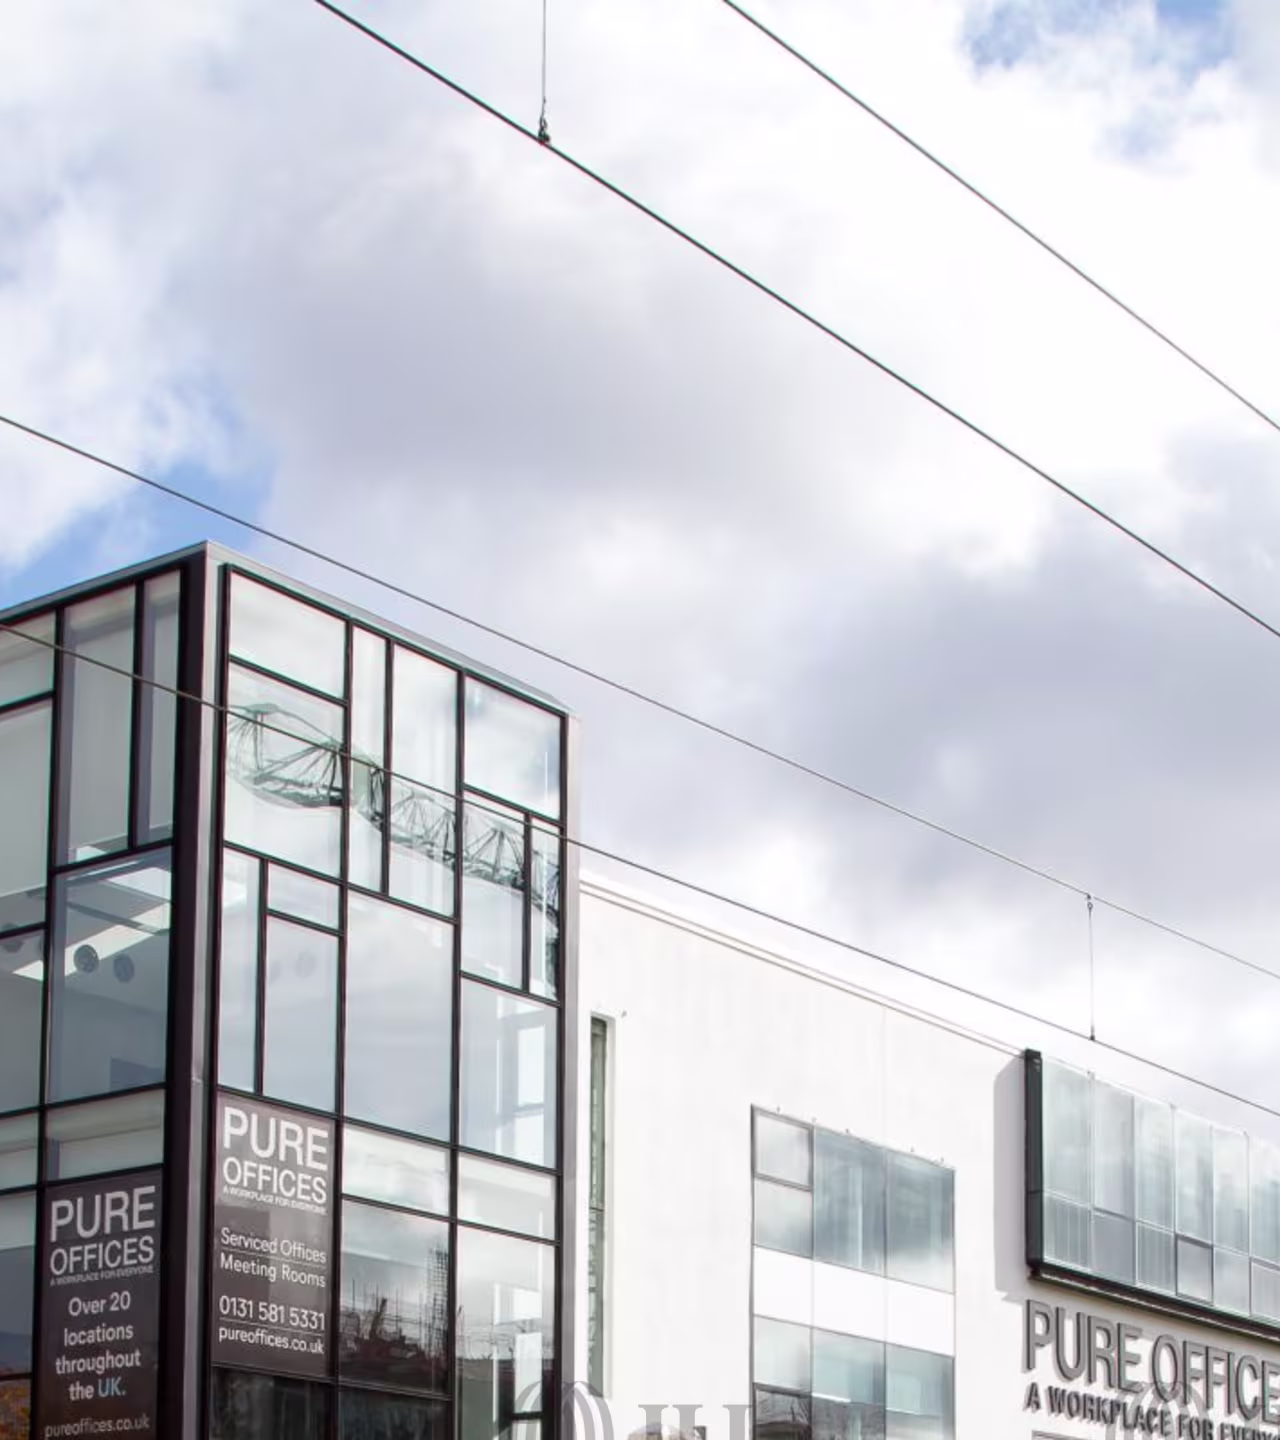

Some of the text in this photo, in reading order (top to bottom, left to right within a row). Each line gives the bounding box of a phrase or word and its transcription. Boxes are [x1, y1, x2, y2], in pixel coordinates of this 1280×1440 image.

[224, 1106, 328, 1171] PURE
[223, 1157, 327, 1204] OFFICES
[50, 1185, 156, 1242] PURE
[50, 1235, 154, 1275] OFFICES
[221, 1227, 327, 1263] Serviced Offices
[221, 1252, 326, 1287] Meeting Rooms
[68, 1290, 131, 1316] Over 20
[220, 1295, 325, 1330] 0131 581 5331
[63, 1322, 134, 1347] locations
[219, 1327, 324, 1354] pureoffices.co.uk
[1023, 1299, 1142, 1394] PURE
[55, 1348, 141, 1375] throughout
[68, 1376, 126, 1401] the UK.
[44, 1412, 150, 1440] pureoffices.co.uk
[1025, 1382, 1042, 1411] A
[1047, 1385, 1170, 1436] WORKPLACE
